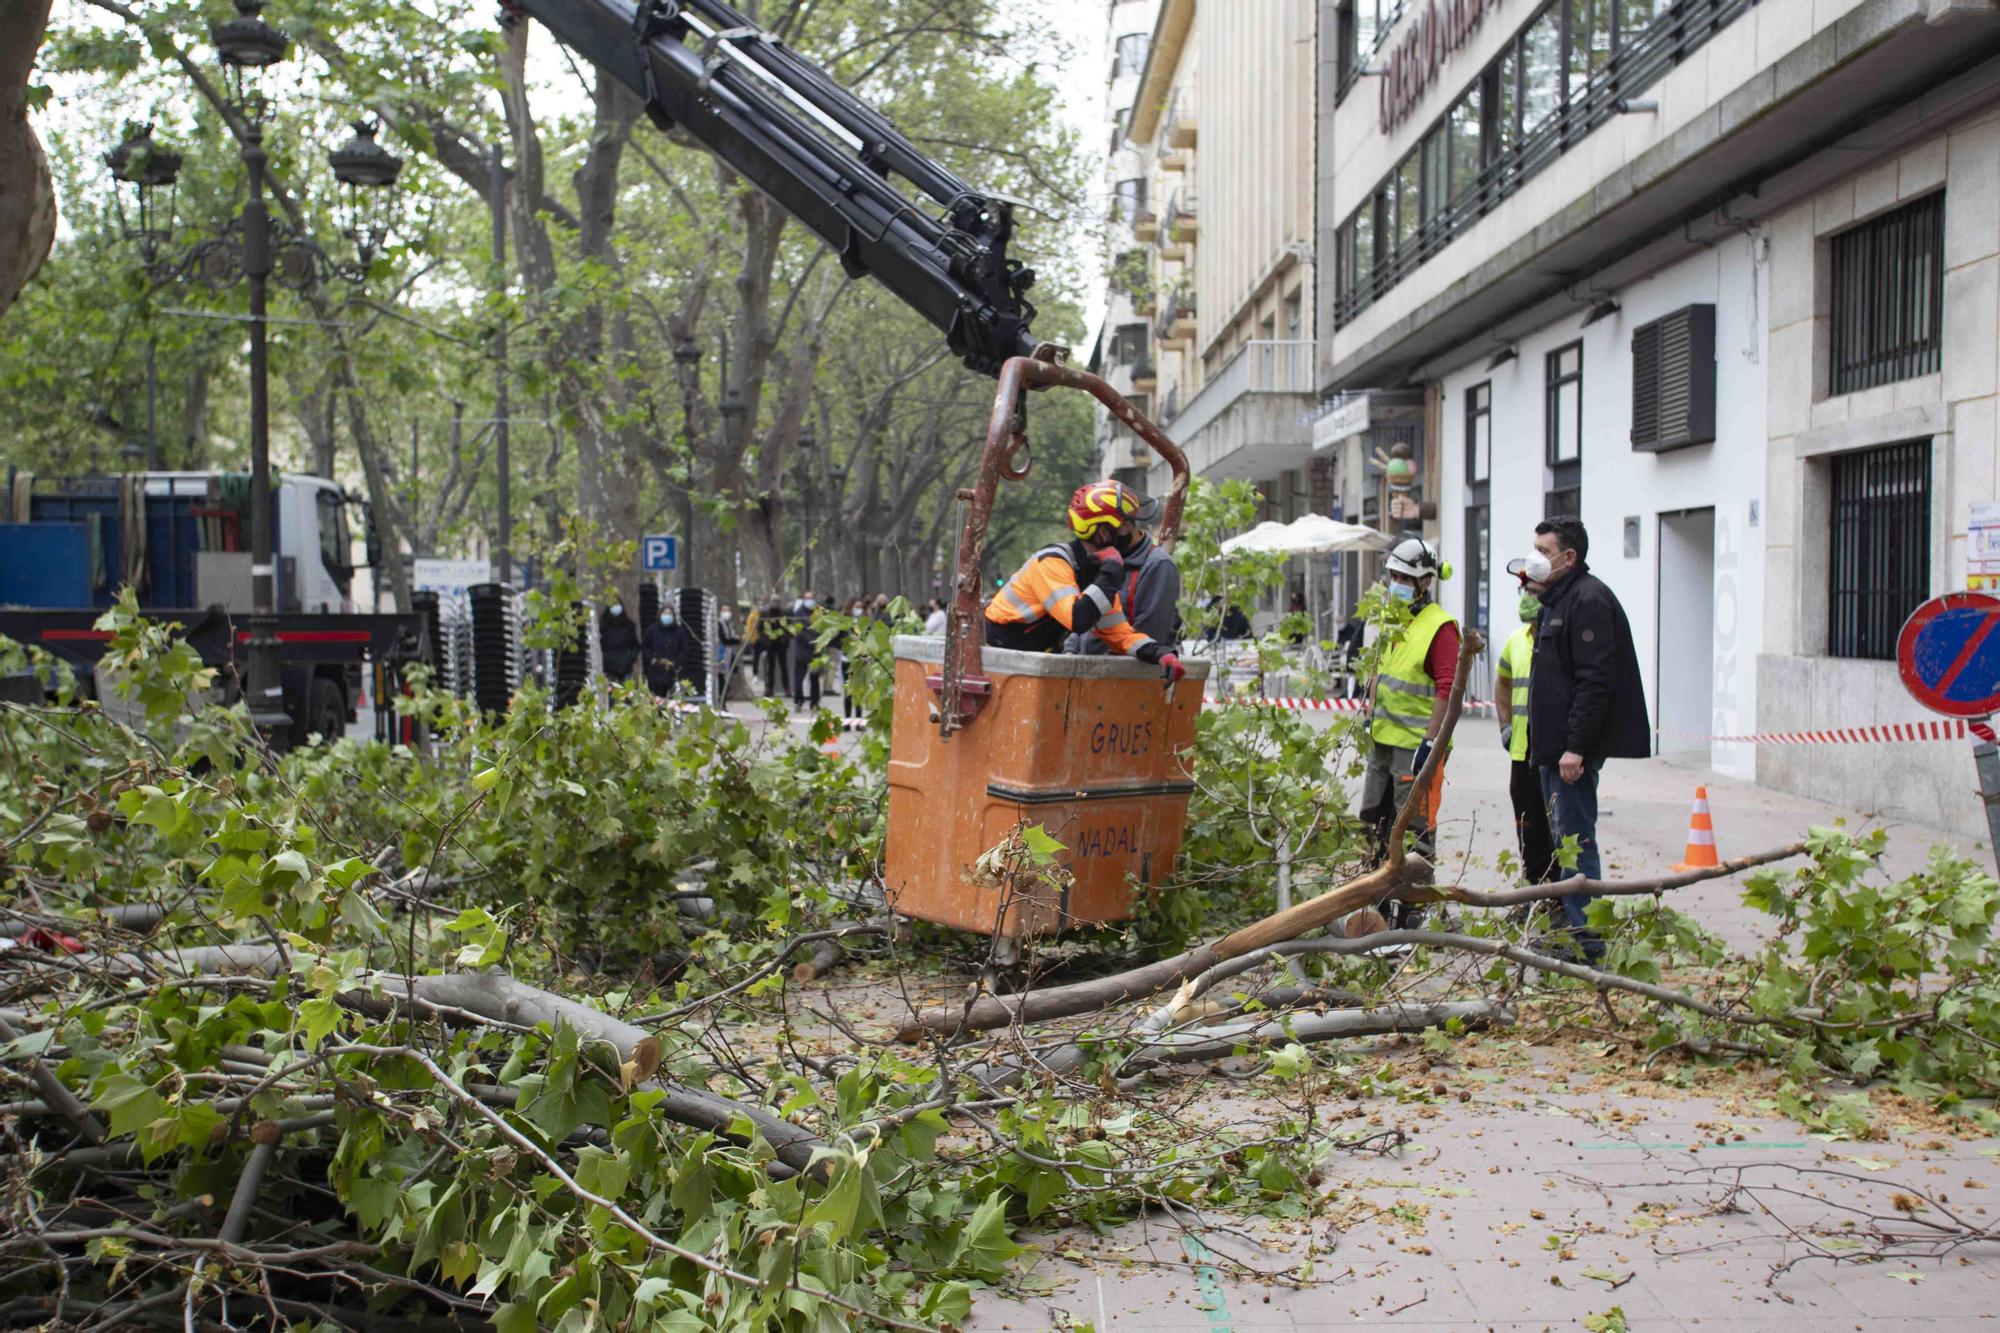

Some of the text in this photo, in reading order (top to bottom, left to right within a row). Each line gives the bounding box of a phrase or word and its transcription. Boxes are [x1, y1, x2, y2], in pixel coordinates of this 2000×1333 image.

[648, 540, 668, 567] P
[1090, 721, 1152, 755] GRUES
[1078, 825, 1137, 857] NADAL
